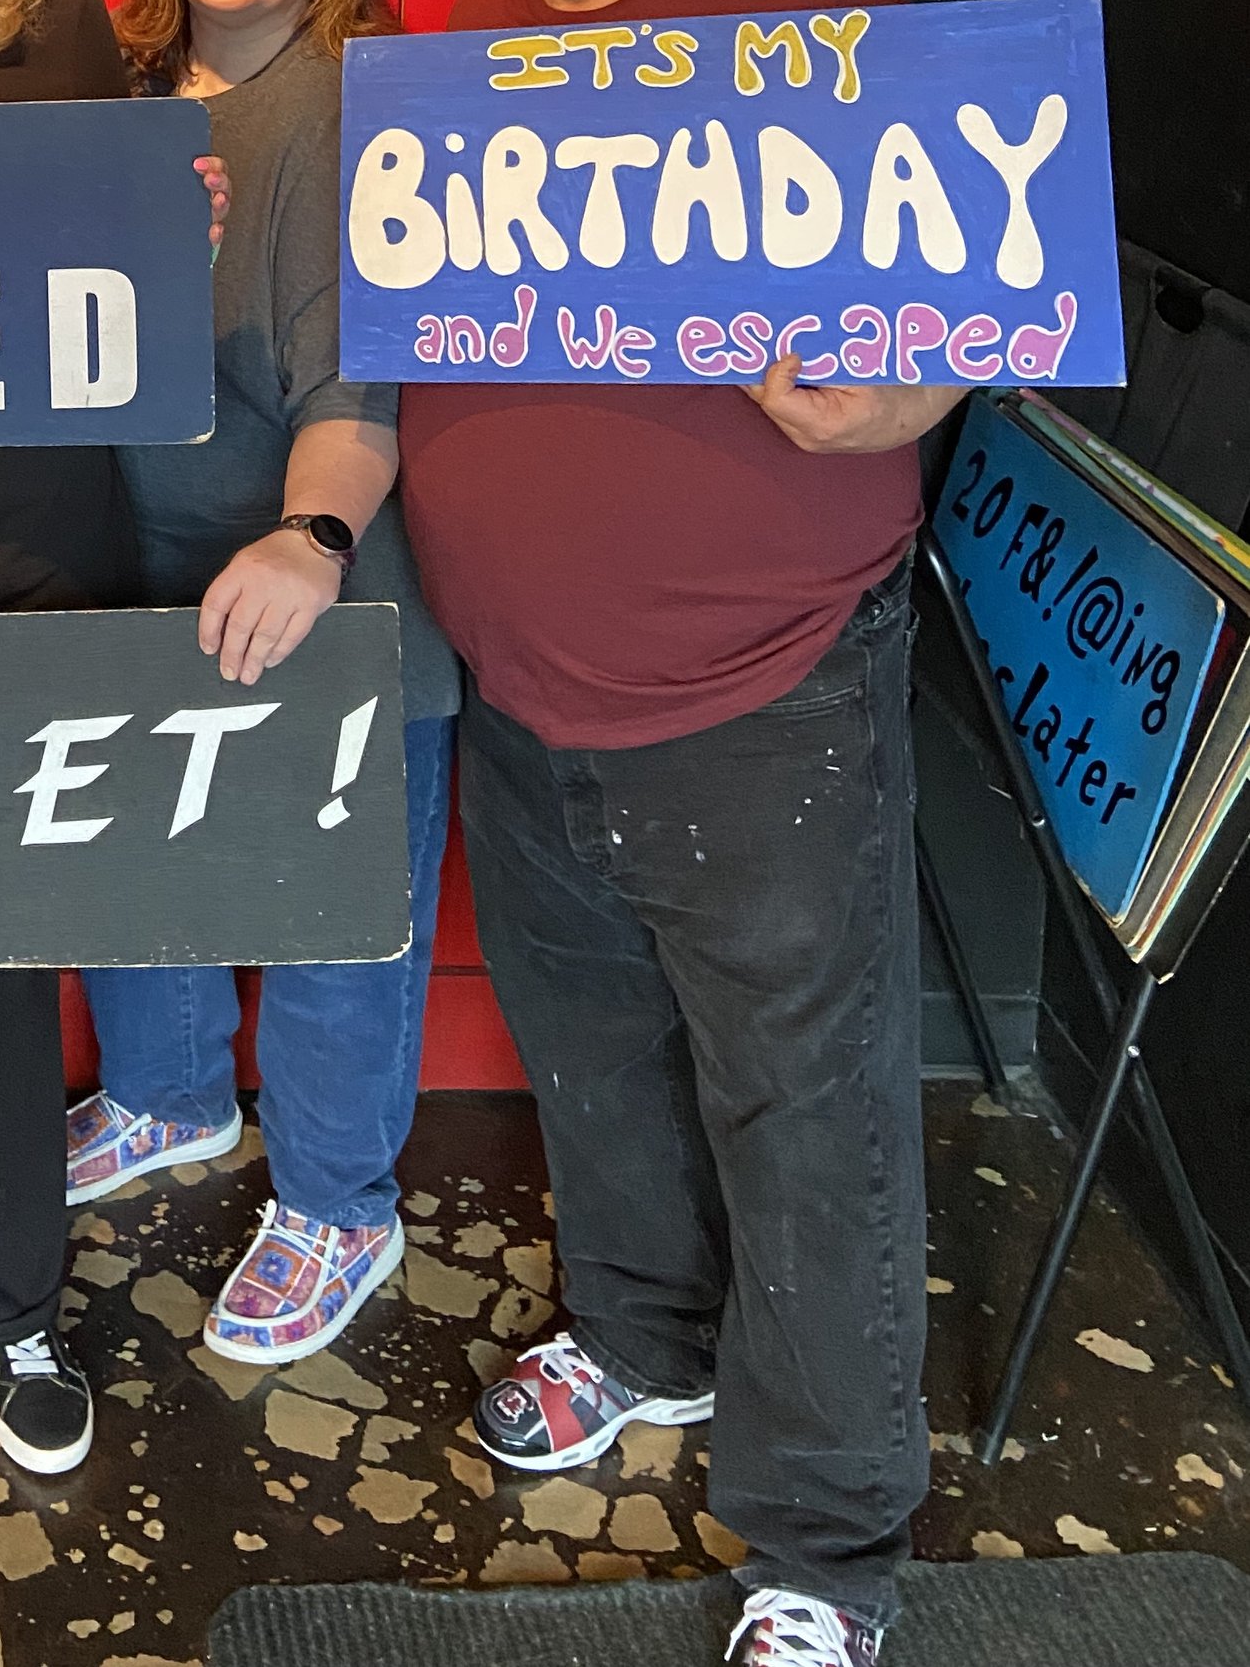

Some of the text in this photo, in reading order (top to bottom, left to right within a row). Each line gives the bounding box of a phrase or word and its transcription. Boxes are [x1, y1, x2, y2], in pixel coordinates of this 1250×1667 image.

[487, 10, 871, 103] IT'S MY
[415, 284, 537, 366] and
[951, 449, 1013, 538] 20
